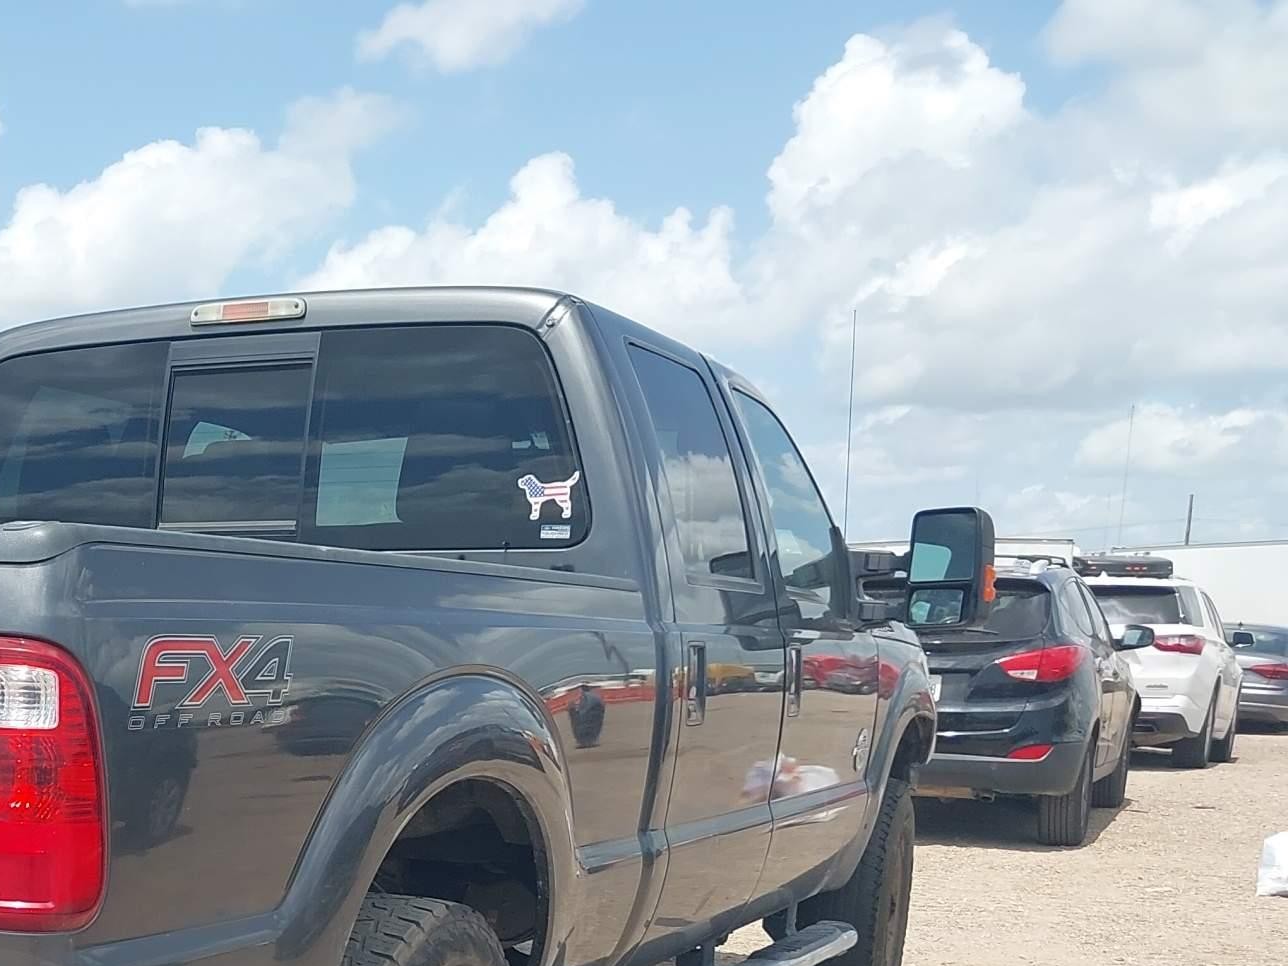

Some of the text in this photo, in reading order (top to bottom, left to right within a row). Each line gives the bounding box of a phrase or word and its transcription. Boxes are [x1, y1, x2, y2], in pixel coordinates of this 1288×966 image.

[131, 634, 295, 711] FX4
[128, 710, 288, 731] OFF ROAD
